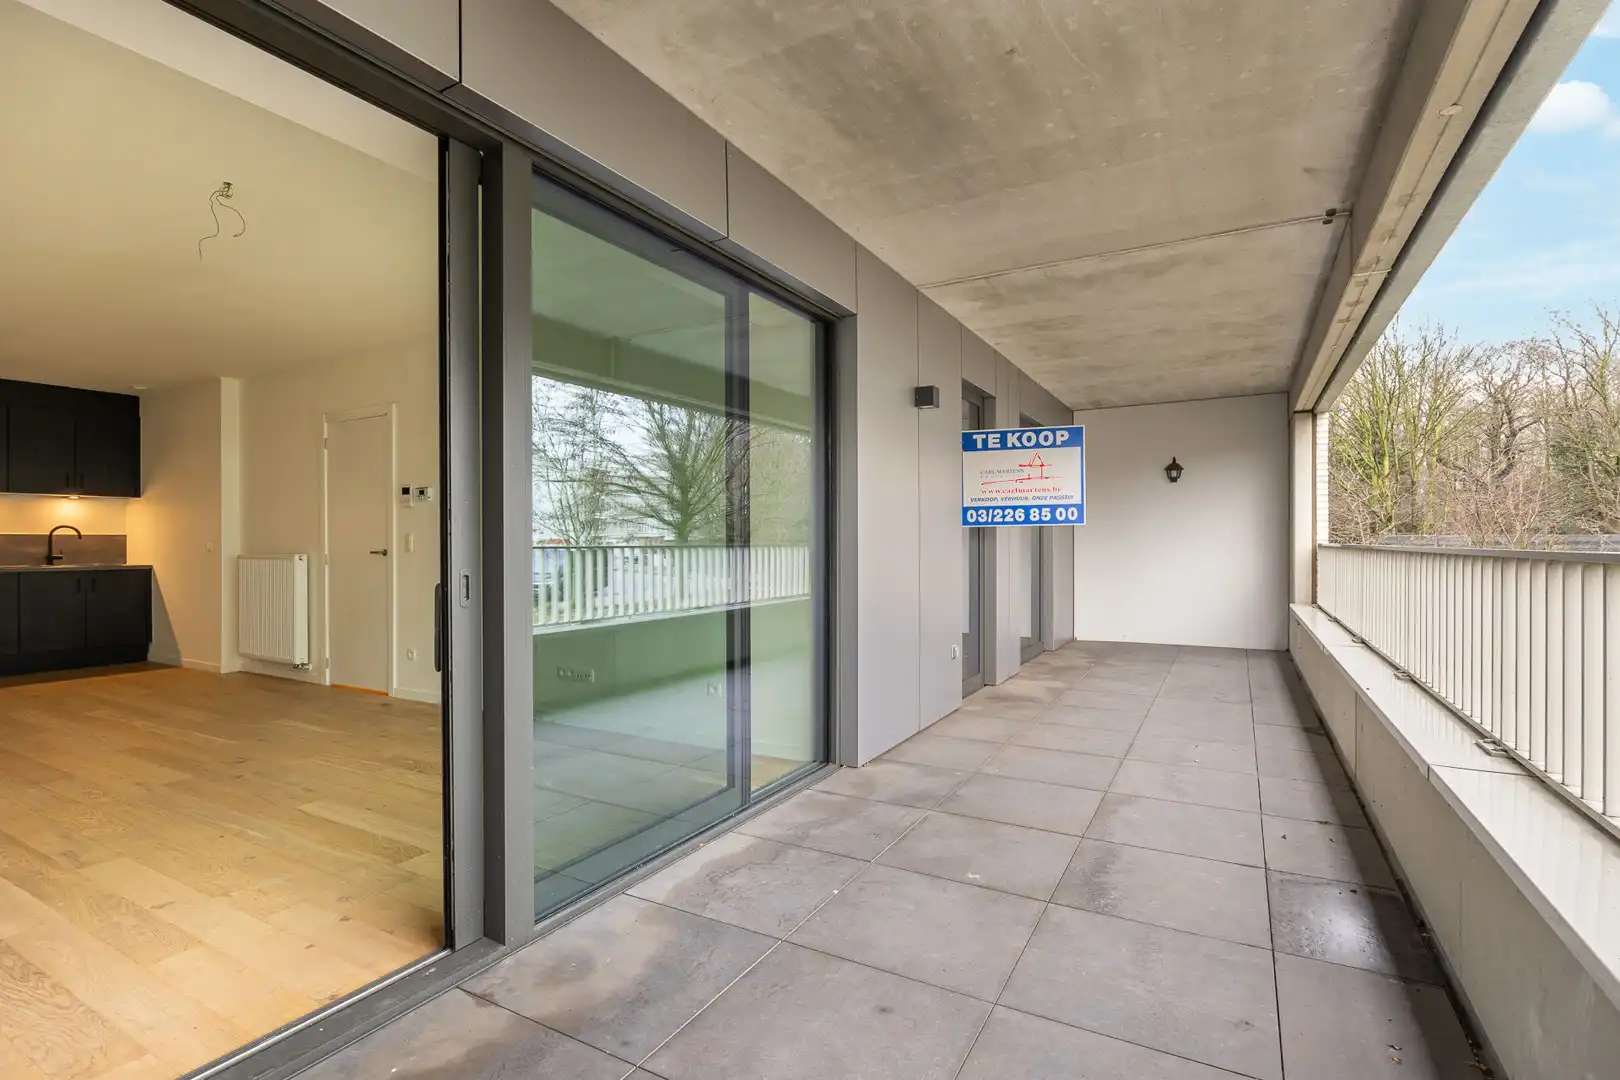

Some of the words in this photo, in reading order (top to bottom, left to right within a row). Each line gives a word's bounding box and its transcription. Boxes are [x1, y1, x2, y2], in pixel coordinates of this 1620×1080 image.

[972, 433, 1001, 449] TE
[1007, 430, 1070, 448] KOOP
[966, 508, 1026, 523] 03/226
[1029, 507, 1052, 522] 85
[1055, 506, 1078, 521] 00
